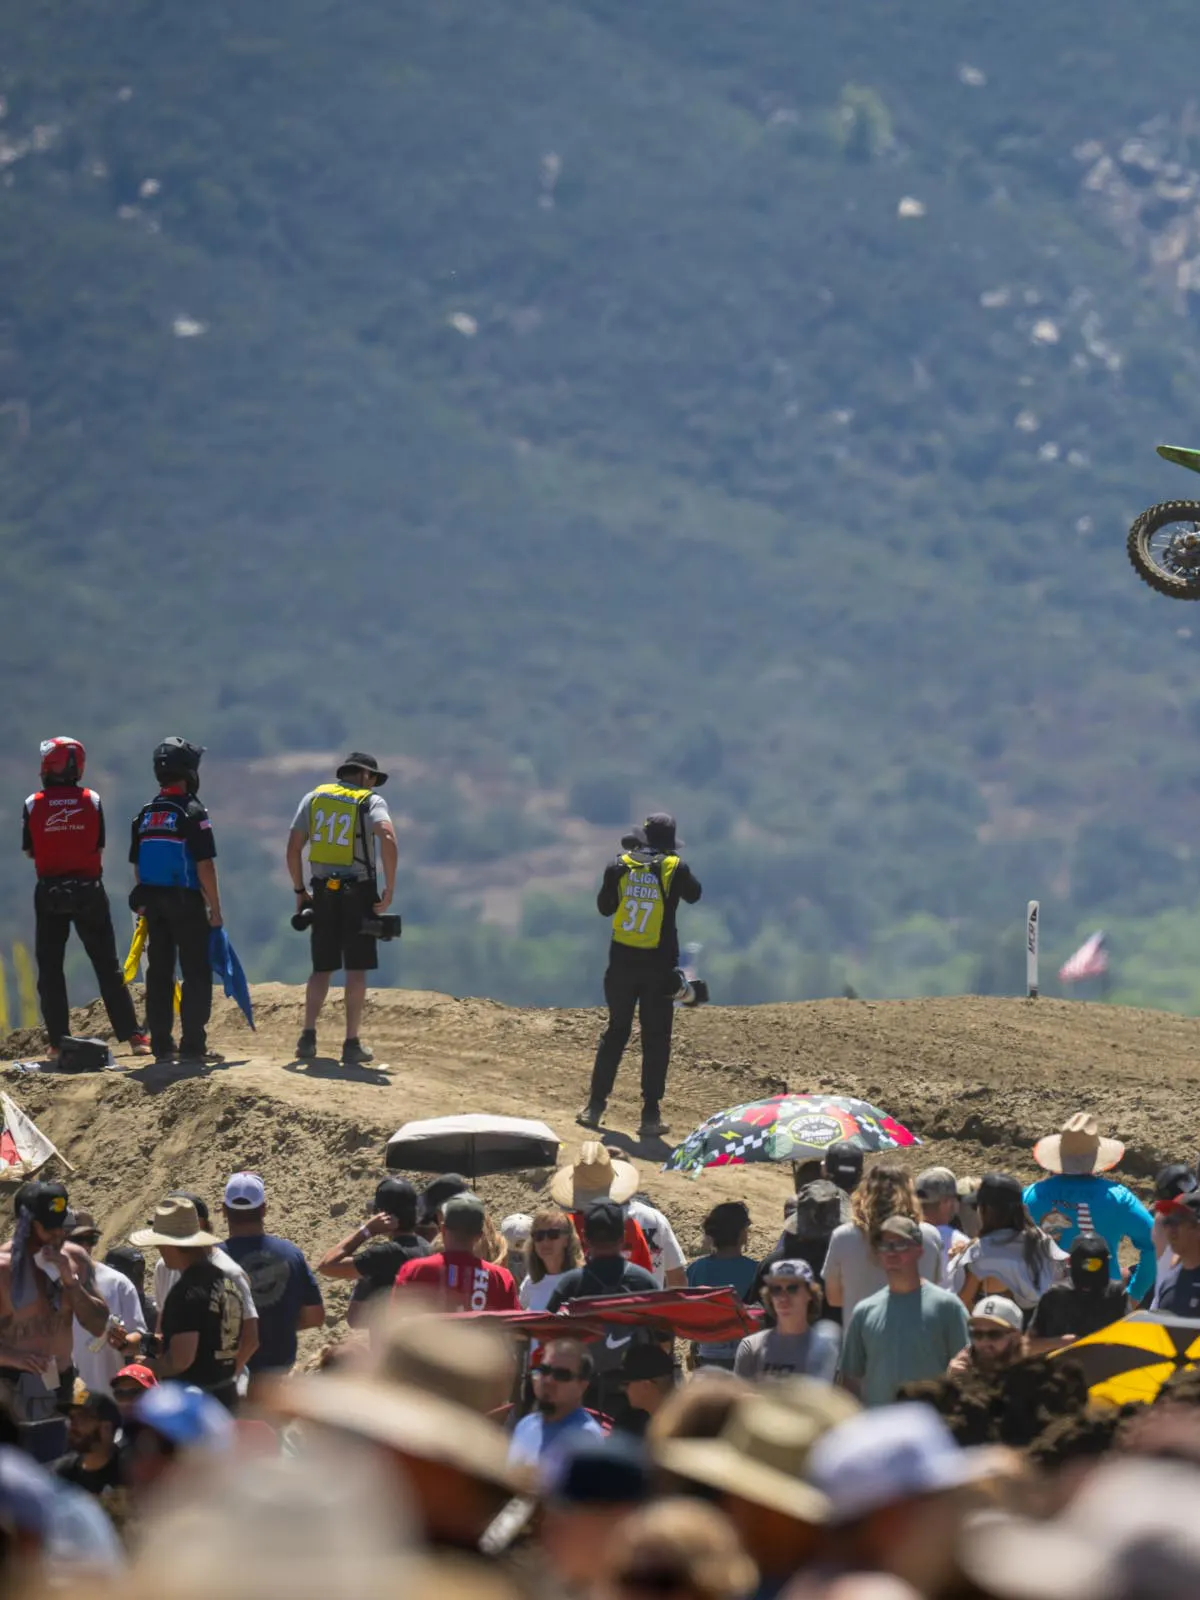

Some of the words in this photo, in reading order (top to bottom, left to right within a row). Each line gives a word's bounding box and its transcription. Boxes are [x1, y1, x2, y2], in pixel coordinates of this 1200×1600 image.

[312, 809, 351, 846] 212
[625, 886, 658, 900] MEDIA
[623, 899, 654, 933] 37
